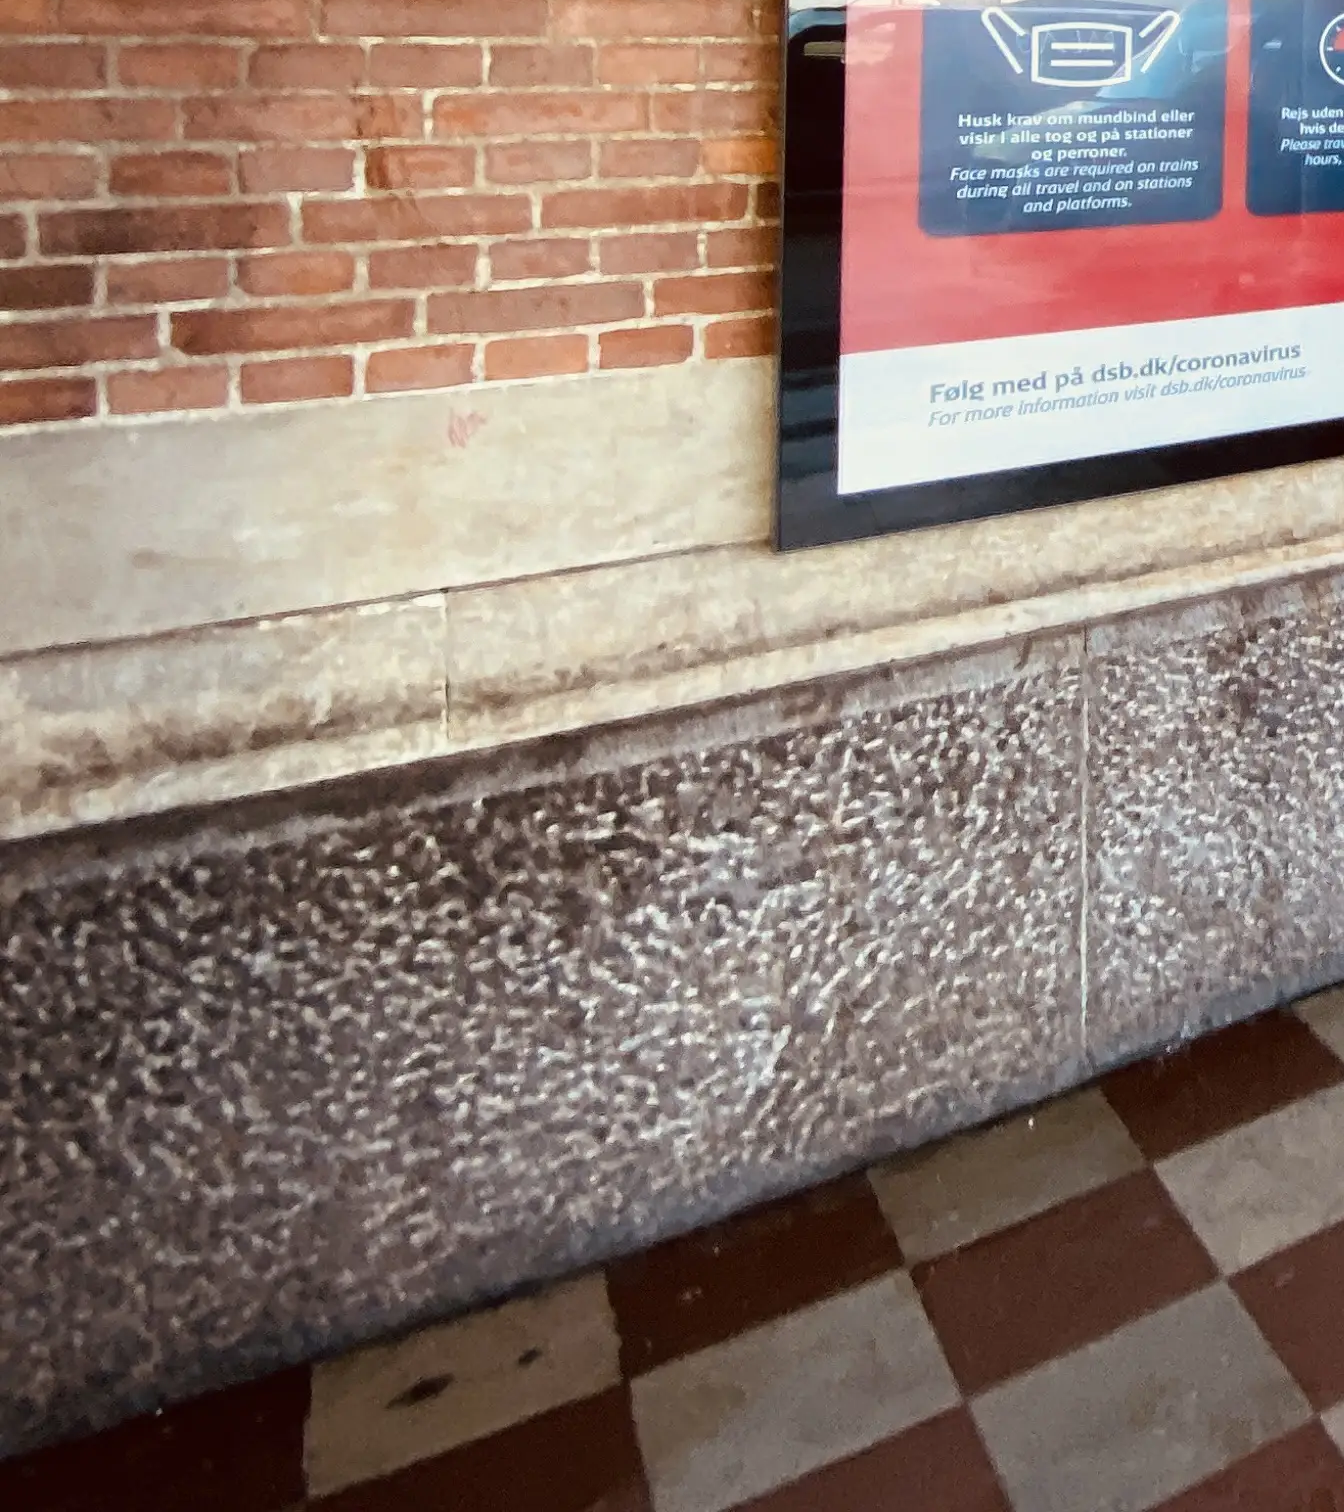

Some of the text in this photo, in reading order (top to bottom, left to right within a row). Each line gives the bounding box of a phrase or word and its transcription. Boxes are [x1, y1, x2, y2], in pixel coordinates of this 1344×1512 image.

[958, 109, 1195, 128] Husk krav om mundbind eller
[1281, 107, 1308, 121] Rejs
[1312, 106, 1344, 119] uden
[960, 131, 995, 145] visir
[1010, 130, 1041, 144] alle
[1046, 129, 1072, 144] tog
[1077, 129, 1097, 142] og
[1102, 126, 1120, 143] på
[1124, 127, 1192, 140] stationer
[1300, 122, 1325, 135] hvis
[1281, 139, 1320, 151] Please
[1031, 148, 1127, 161] og perroner.
[1304, 154, 1342, 166] hours,
[950, 159, 1199, 180] Face masks are required on trains
[956, 176, 1192, 199] during all travel and on stations
[1023, 196, 1132, 214] and platforms.
[929, 343, 1302, 404] Følg med på dsb.dk/coronavirus
[927, 365, 1306, 428] For more information visit dsb.dk/coronavirus
